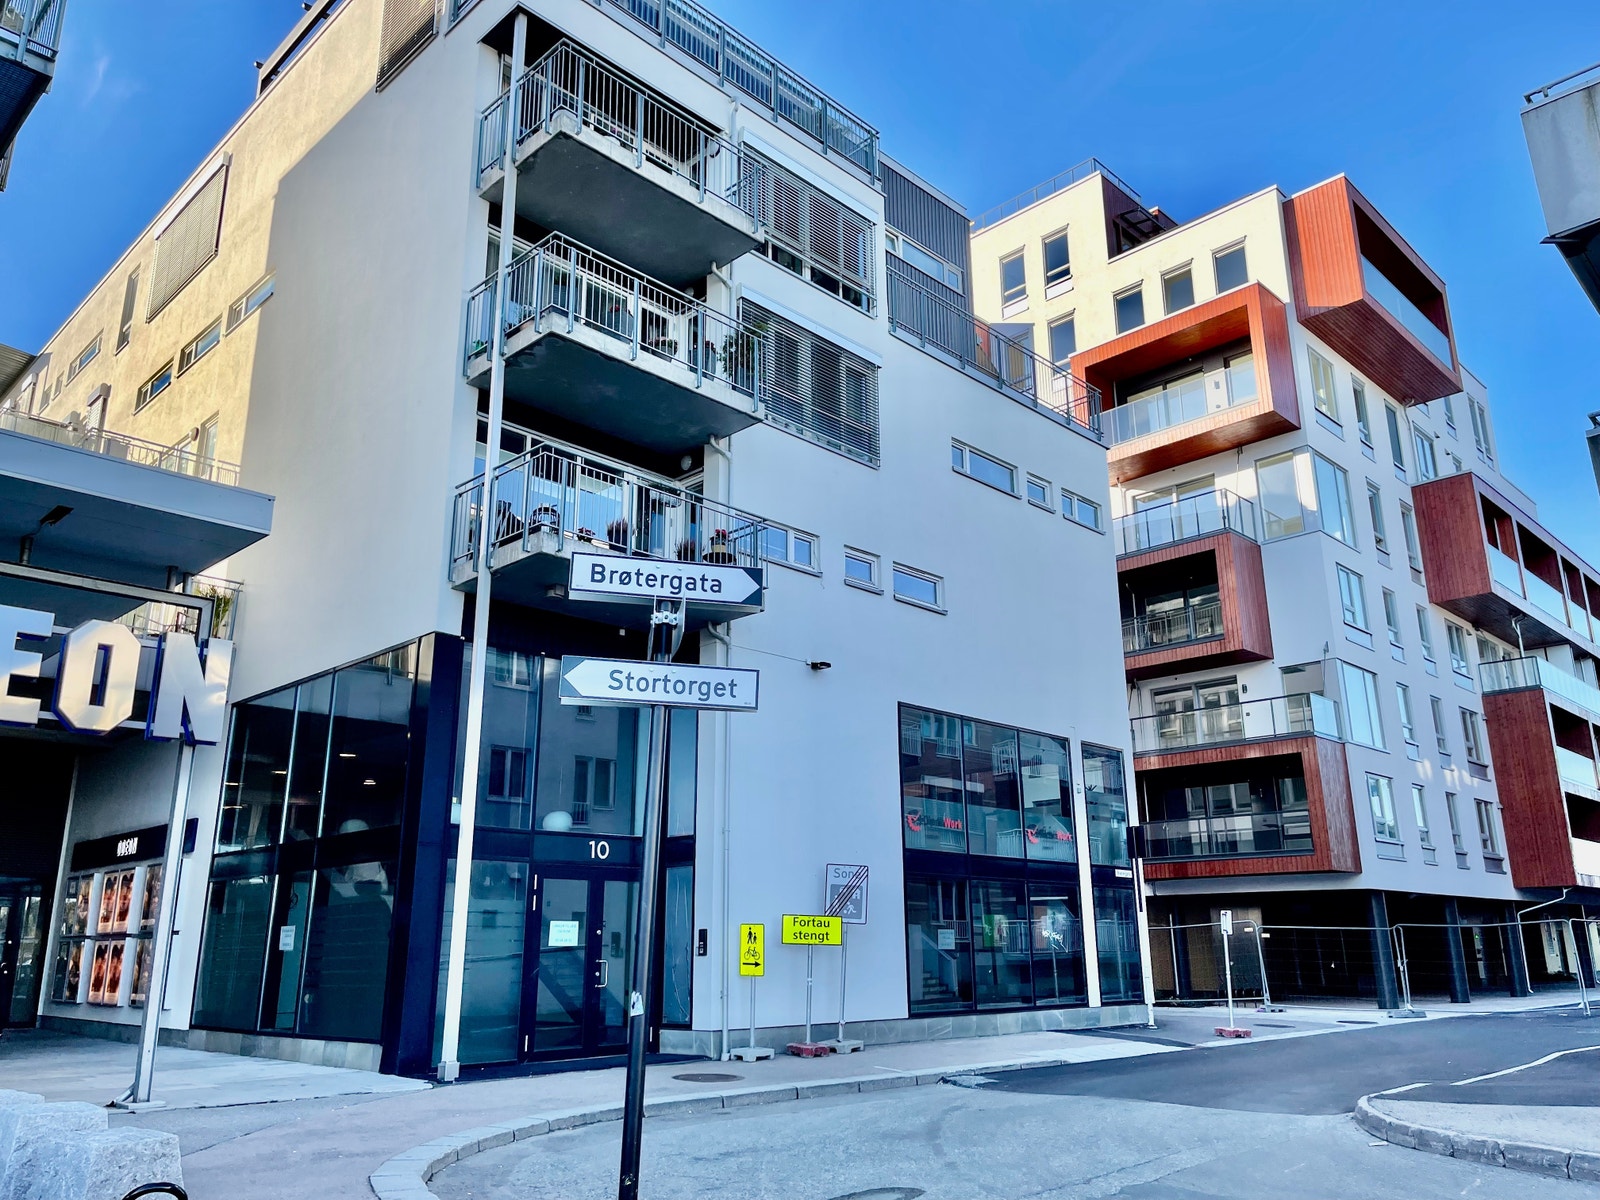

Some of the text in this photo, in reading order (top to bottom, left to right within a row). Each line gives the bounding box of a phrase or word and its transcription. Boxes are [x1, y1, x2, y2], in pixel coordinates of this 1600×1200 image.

[590, 563, 723, 595] Brøtergata
[608, 669, 738, 701] Stortorget
[589, 840, 610, 859] 10
[833, 868, 861, 879] Son
[793, 917, 830, 928] Fortau
[793, 931, 830, 943] stengt
